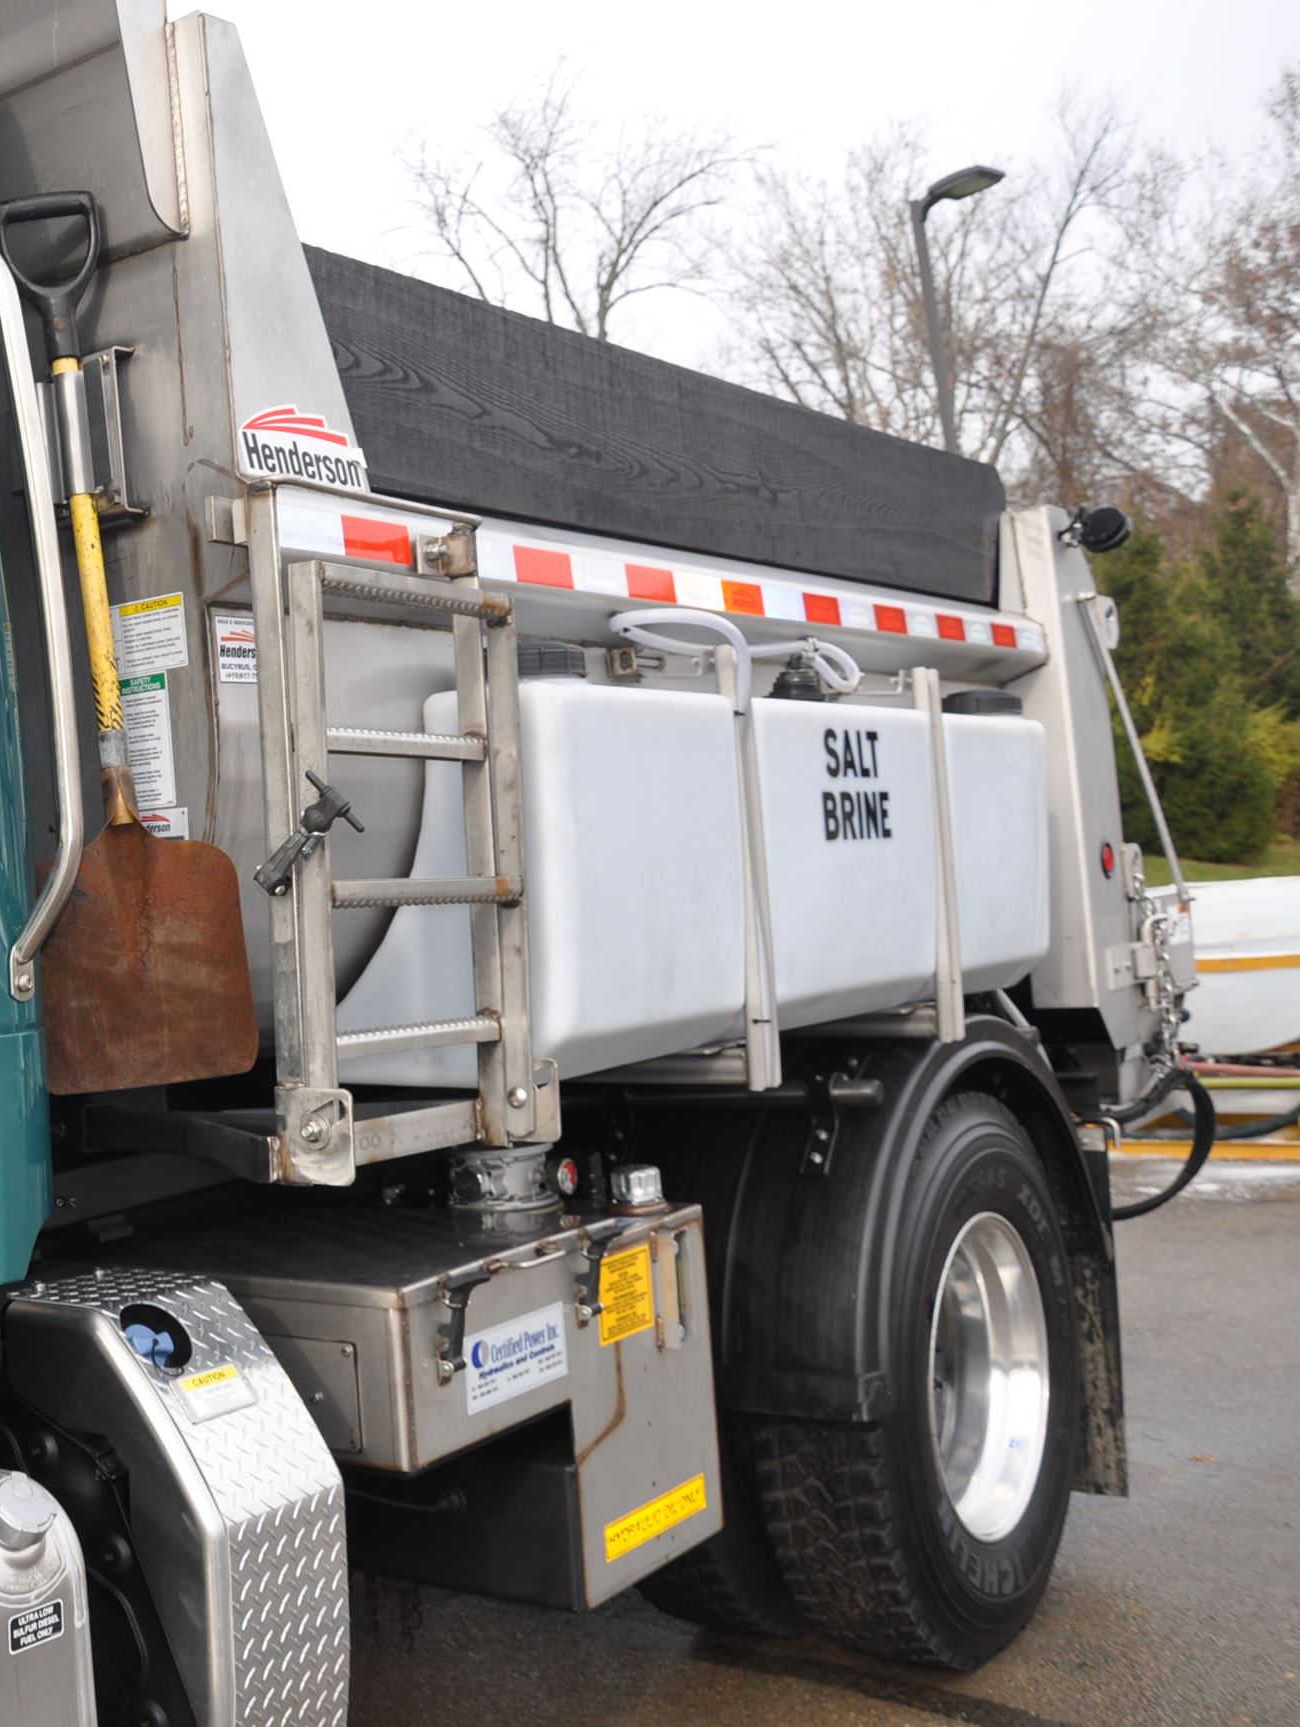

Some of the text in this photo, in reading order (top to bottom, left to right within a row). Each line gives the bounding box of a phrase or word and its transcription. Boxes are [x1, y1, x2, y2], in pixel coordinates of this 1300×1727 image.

[241, 431, 362, 488] Henderson
[140, 600, 168, 611] CAUTION
[220, 644, 257, 660] Henders
[121, 681, 161, 696] INSTRUCTIONS
[129, 676, 152, 687] SAFETY
[823, 727, 879, 779] SALT
[821, 790, 893, 841] BRINE
[491, 1334, 523, 1363] Certified
[524, 1328, 545, 1351] Power
[515, 1353, 528, 1365] and
[191, 1371, 227, 1388] CAUTION
[18, 1605, 54, 1626] ULTRA LOW
[12, 1614, 60, 1639] SULFUR DIESEL
[20, 1625, 54, 1646] FUEL ONLY
